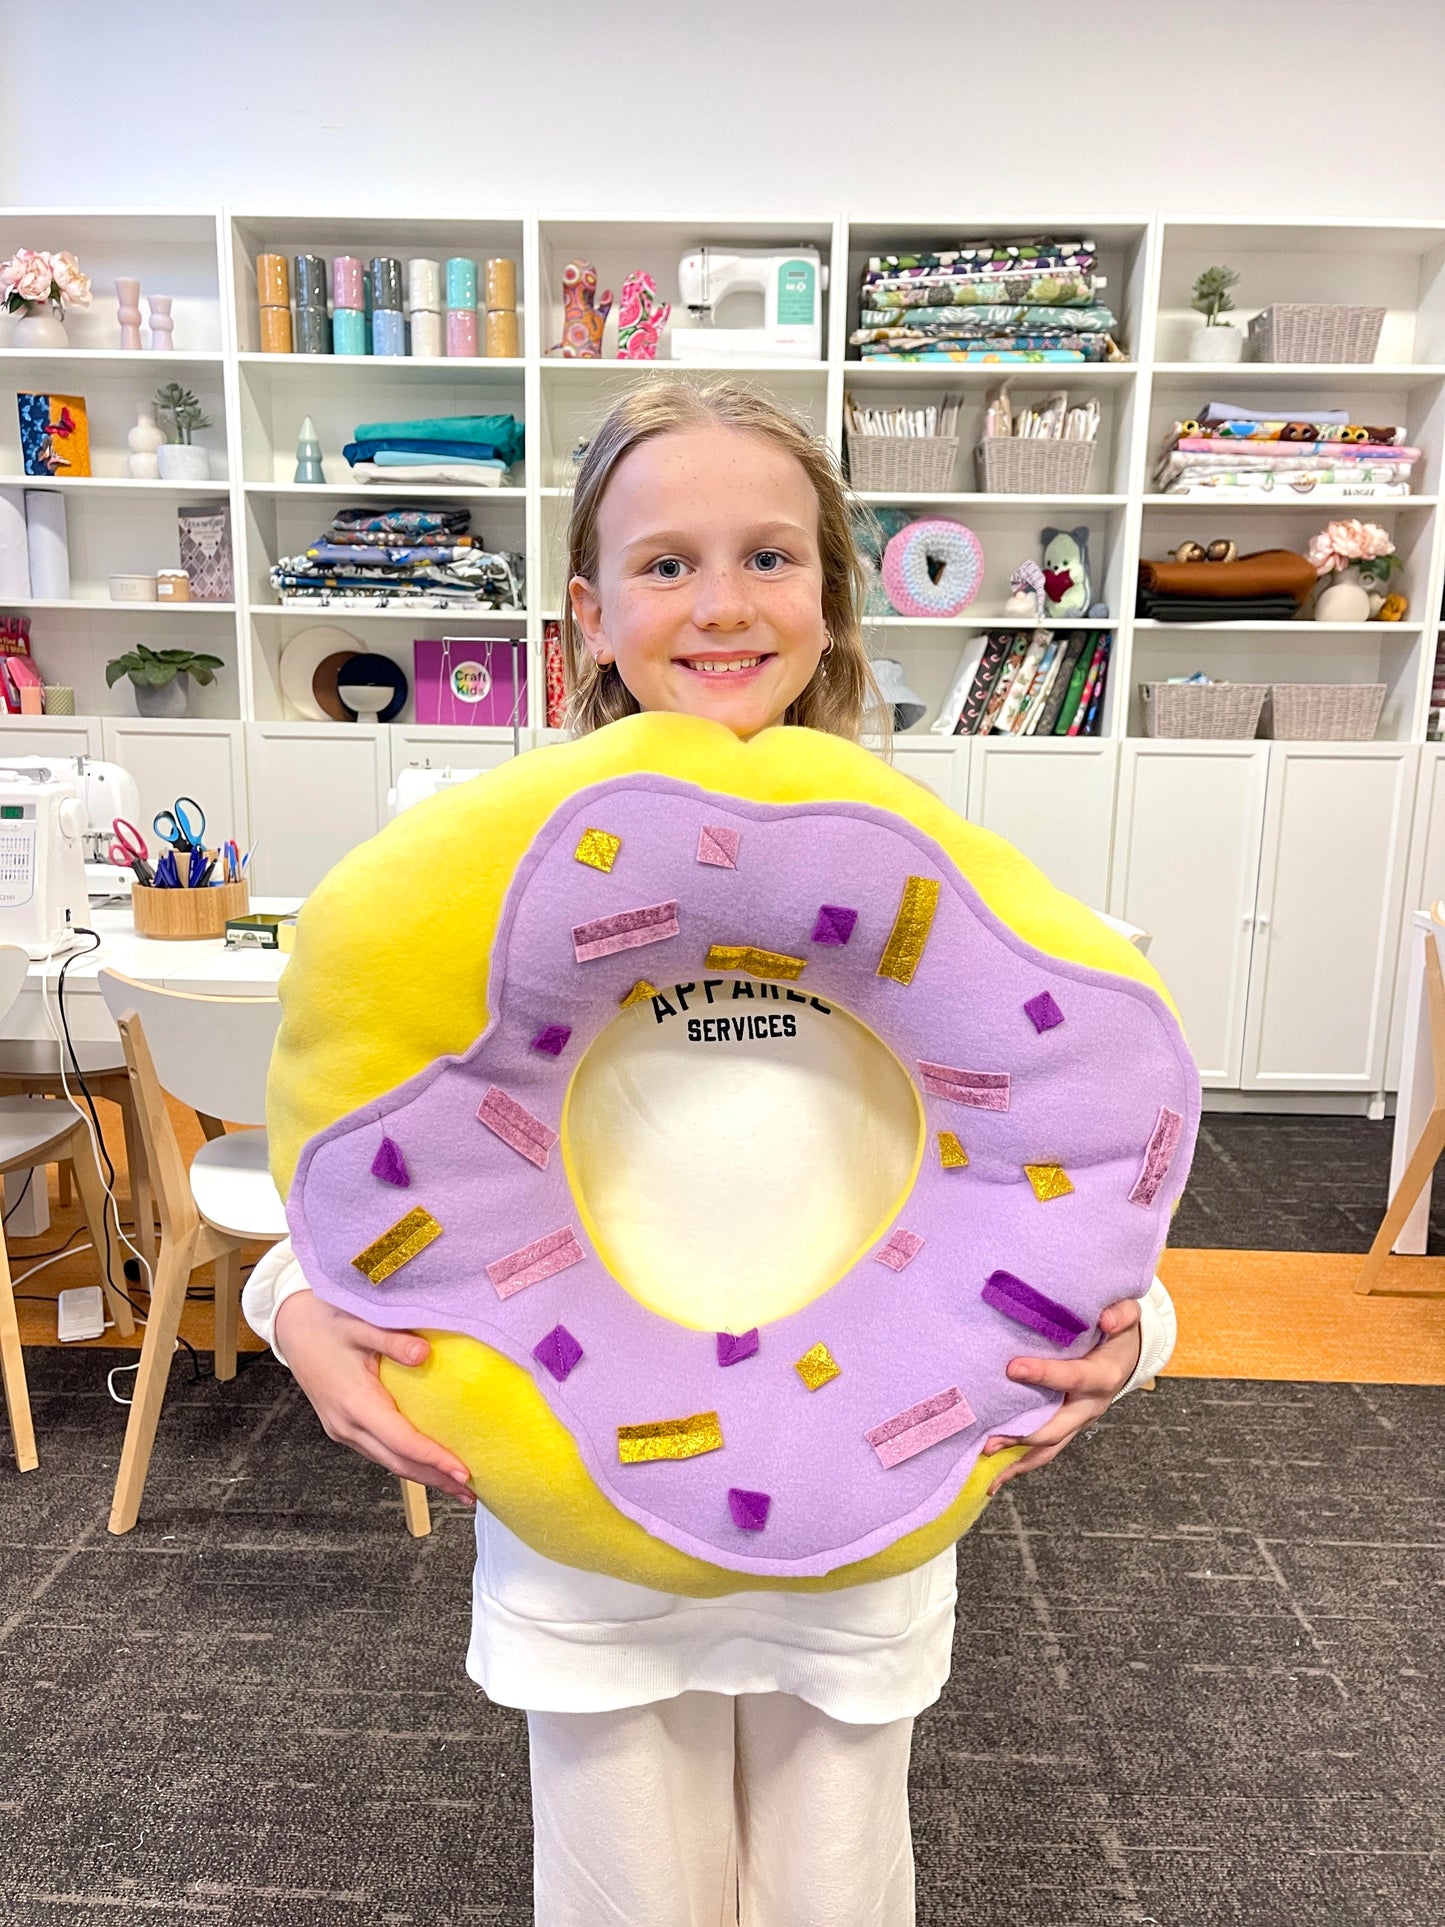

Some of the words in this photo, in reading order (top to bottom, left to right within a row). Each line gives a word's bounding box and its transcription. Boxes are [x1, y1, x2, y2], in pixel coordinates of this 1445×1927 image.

[455, 670, 486, 682] Craft
[457, 685, 485, 696] Kids
[688, 1014, 797, 1042] SERVICES
